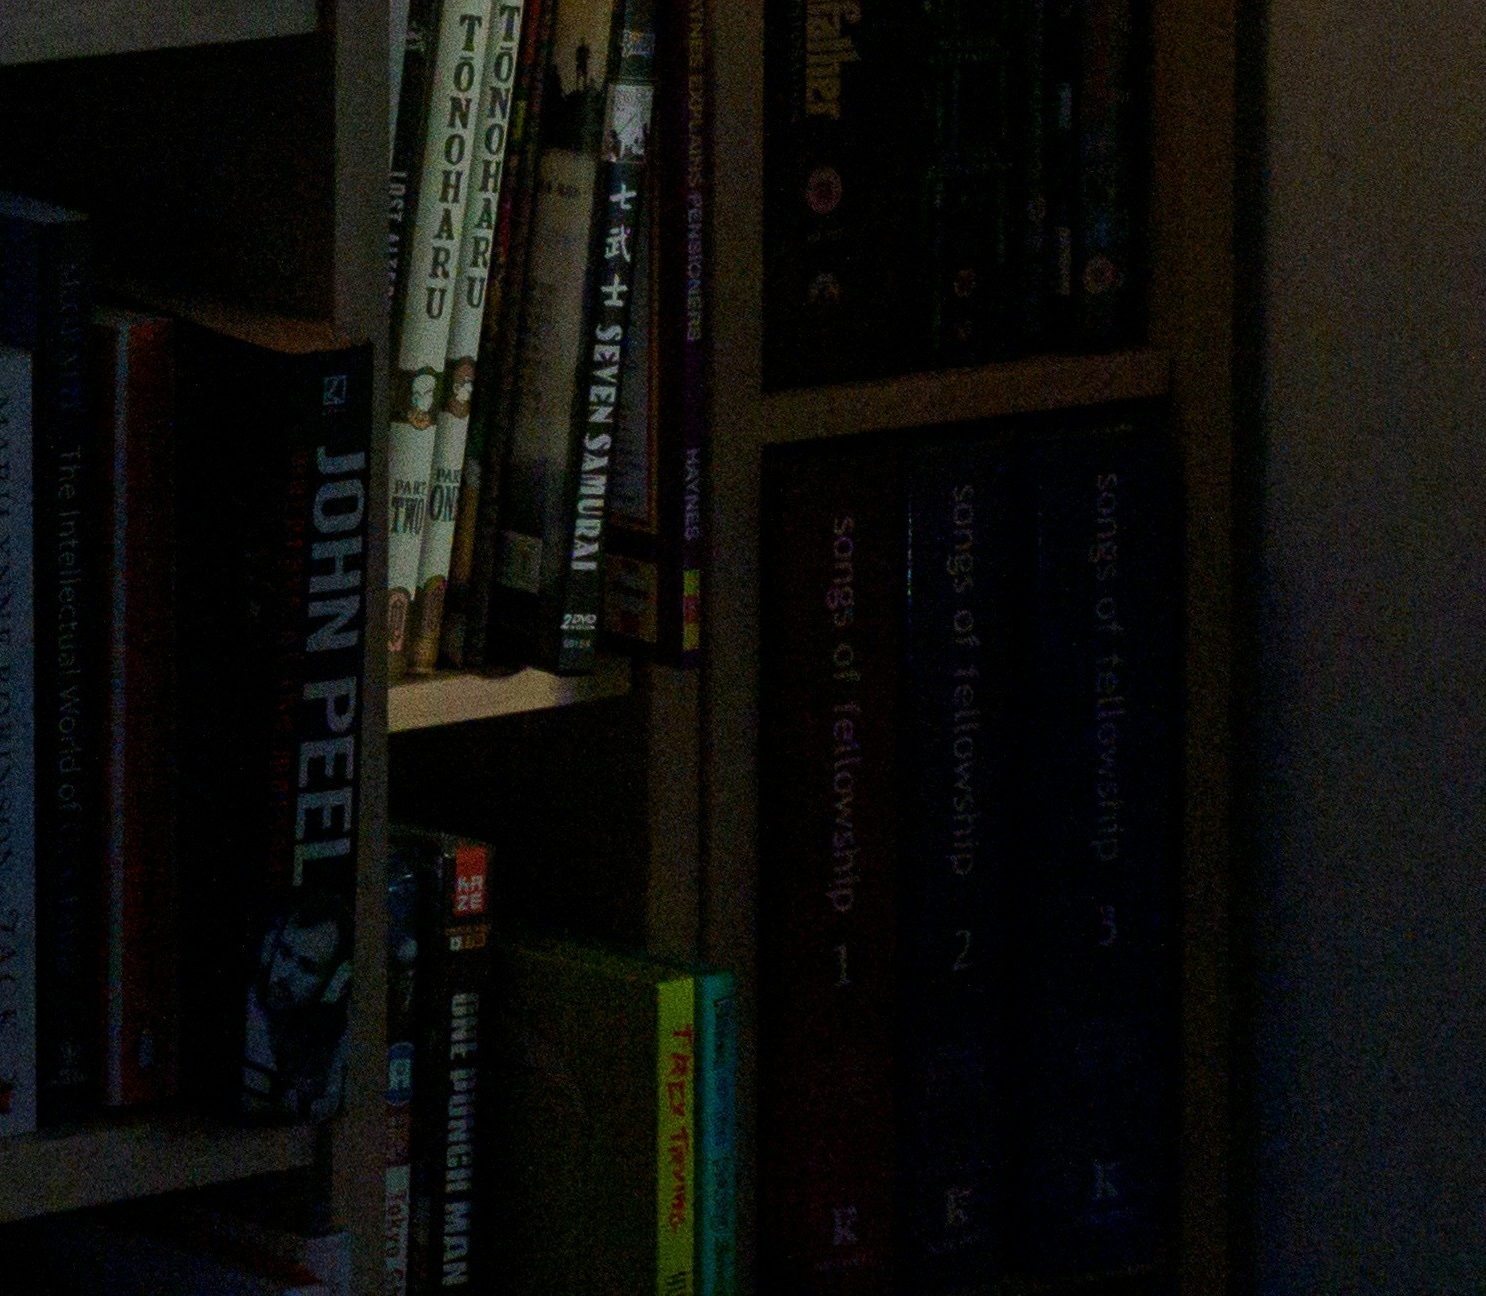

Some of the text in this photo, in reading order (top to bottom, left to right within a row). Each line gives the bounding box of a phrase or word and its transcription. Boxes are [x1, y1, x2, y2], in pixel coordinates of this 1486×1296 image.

[588, 323, 624, 425] SEVEN
[300, 444, 371, 651] JOHN
[570, 431, 613, 572] SAMURAI
[823, 514, 857, 627] songs
[56, 446, 83, 814] The Intellectual World of
[831, 642, 860, 683] of
[291, 677, 354, 888] PEEL
[825, 699, 860, 913] fellowship
[441, 992, 480, 1287] ONE PUNCH MAN
